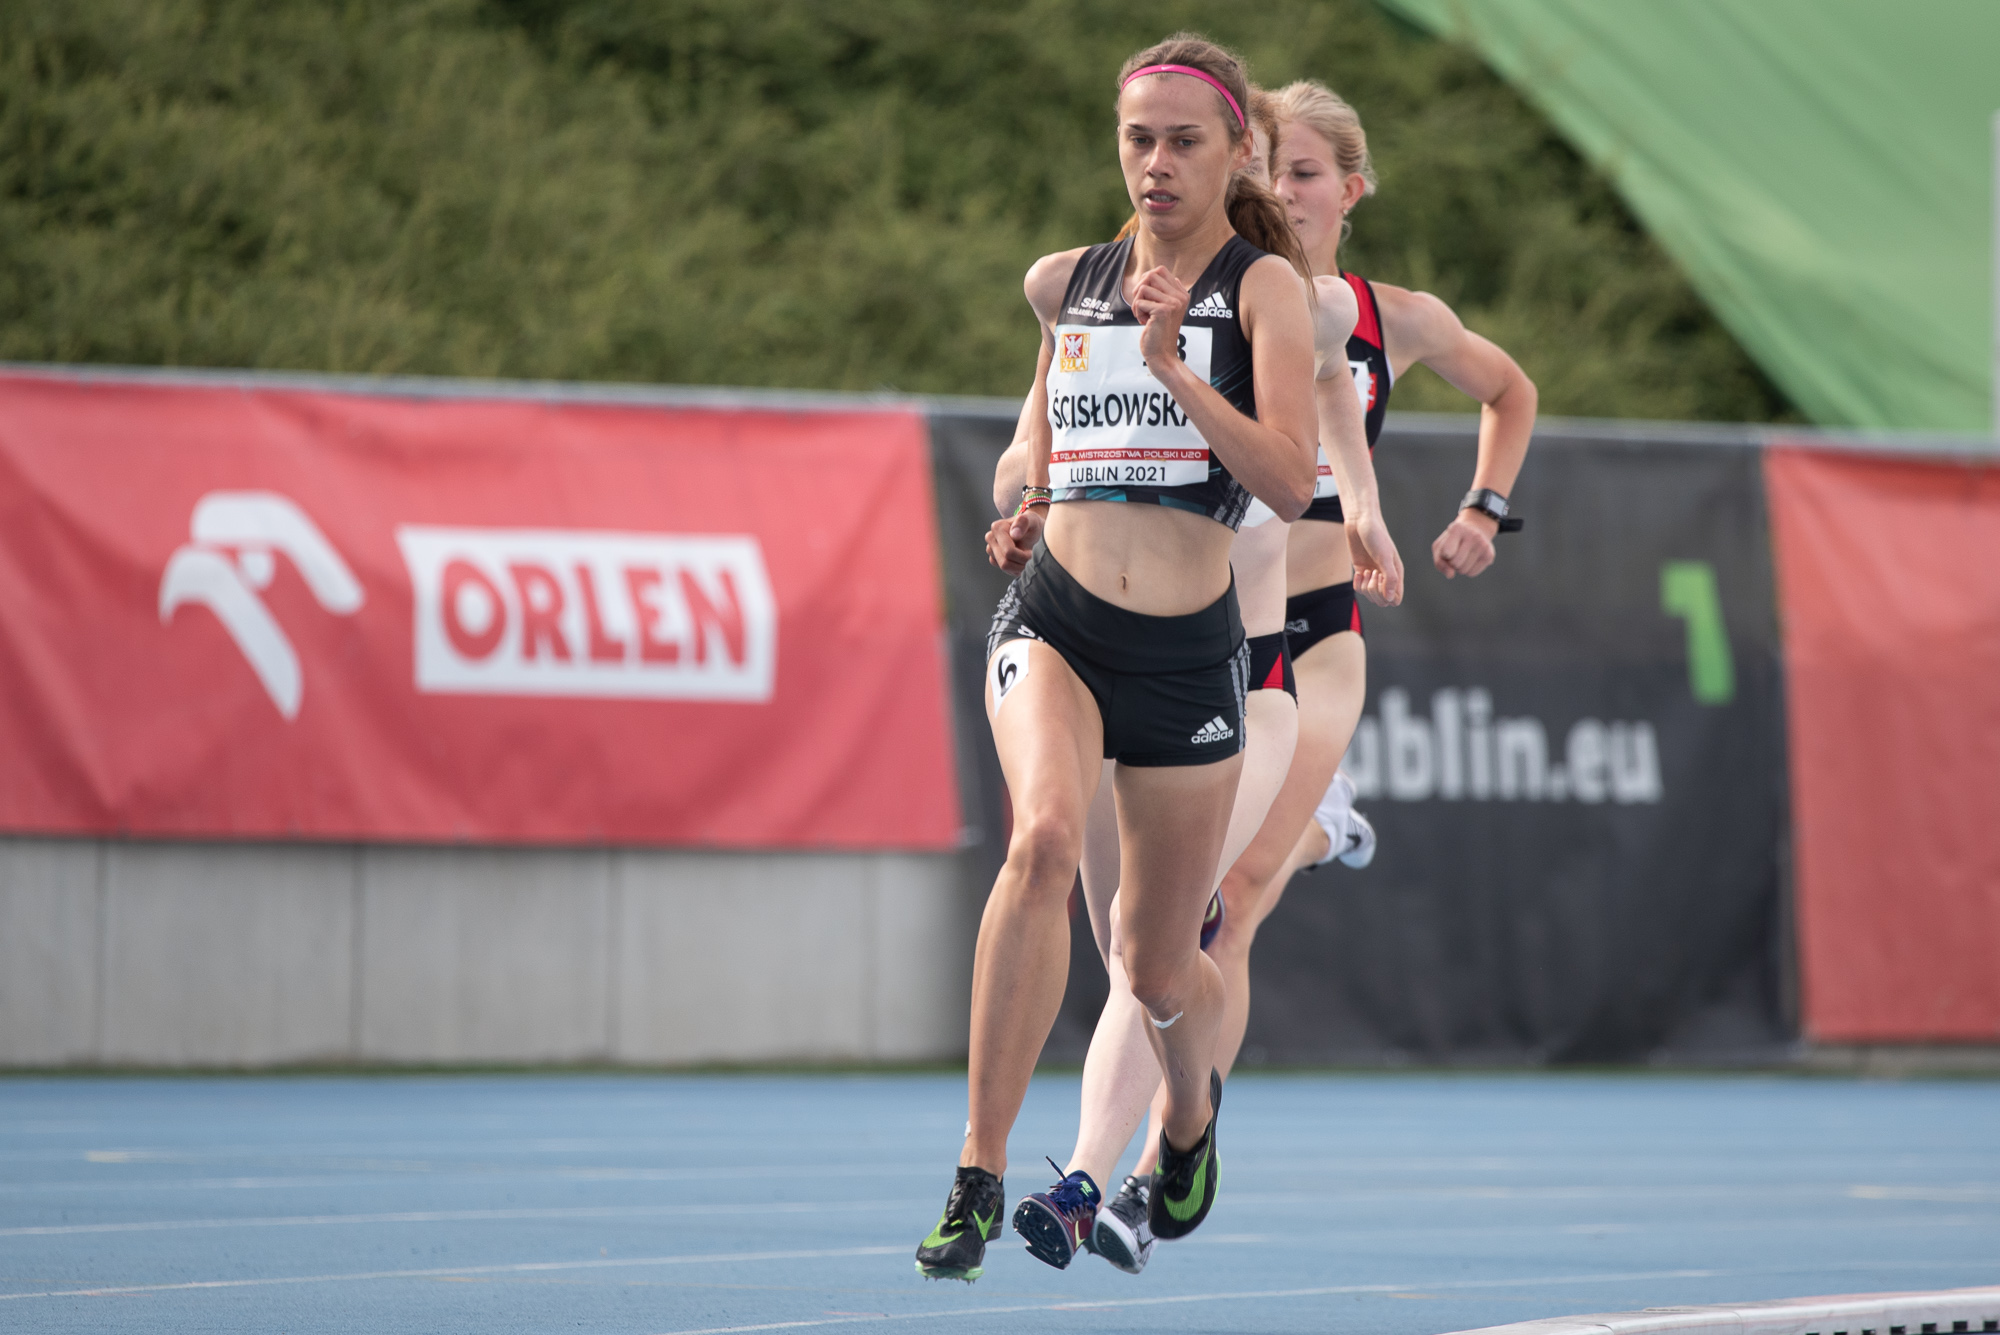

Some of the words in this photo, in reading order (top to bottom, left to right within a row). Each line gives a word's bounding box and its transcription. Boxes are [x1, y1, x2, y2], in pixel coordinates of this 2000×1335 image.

[1081, 297, 1110, 312] SMS
[1189, 307, 1233, 319] adidas
[1060, 452, 1077, 461] PZLA
[1079, 450, 1142, 459] MISTRZOSTWA
[1143, 450, 1179, 459] POLSKI
[1181, 451, 1202, 459] U20
[1070, 466, 1119, 483] LUBLIN
[1124, 466, 1166, 482] 2021
[441, 554, 748, 668] ORLEN
[1191, 728, 1234, 744] adidas
[1341, 686, 1664, 803] ublin.eu
